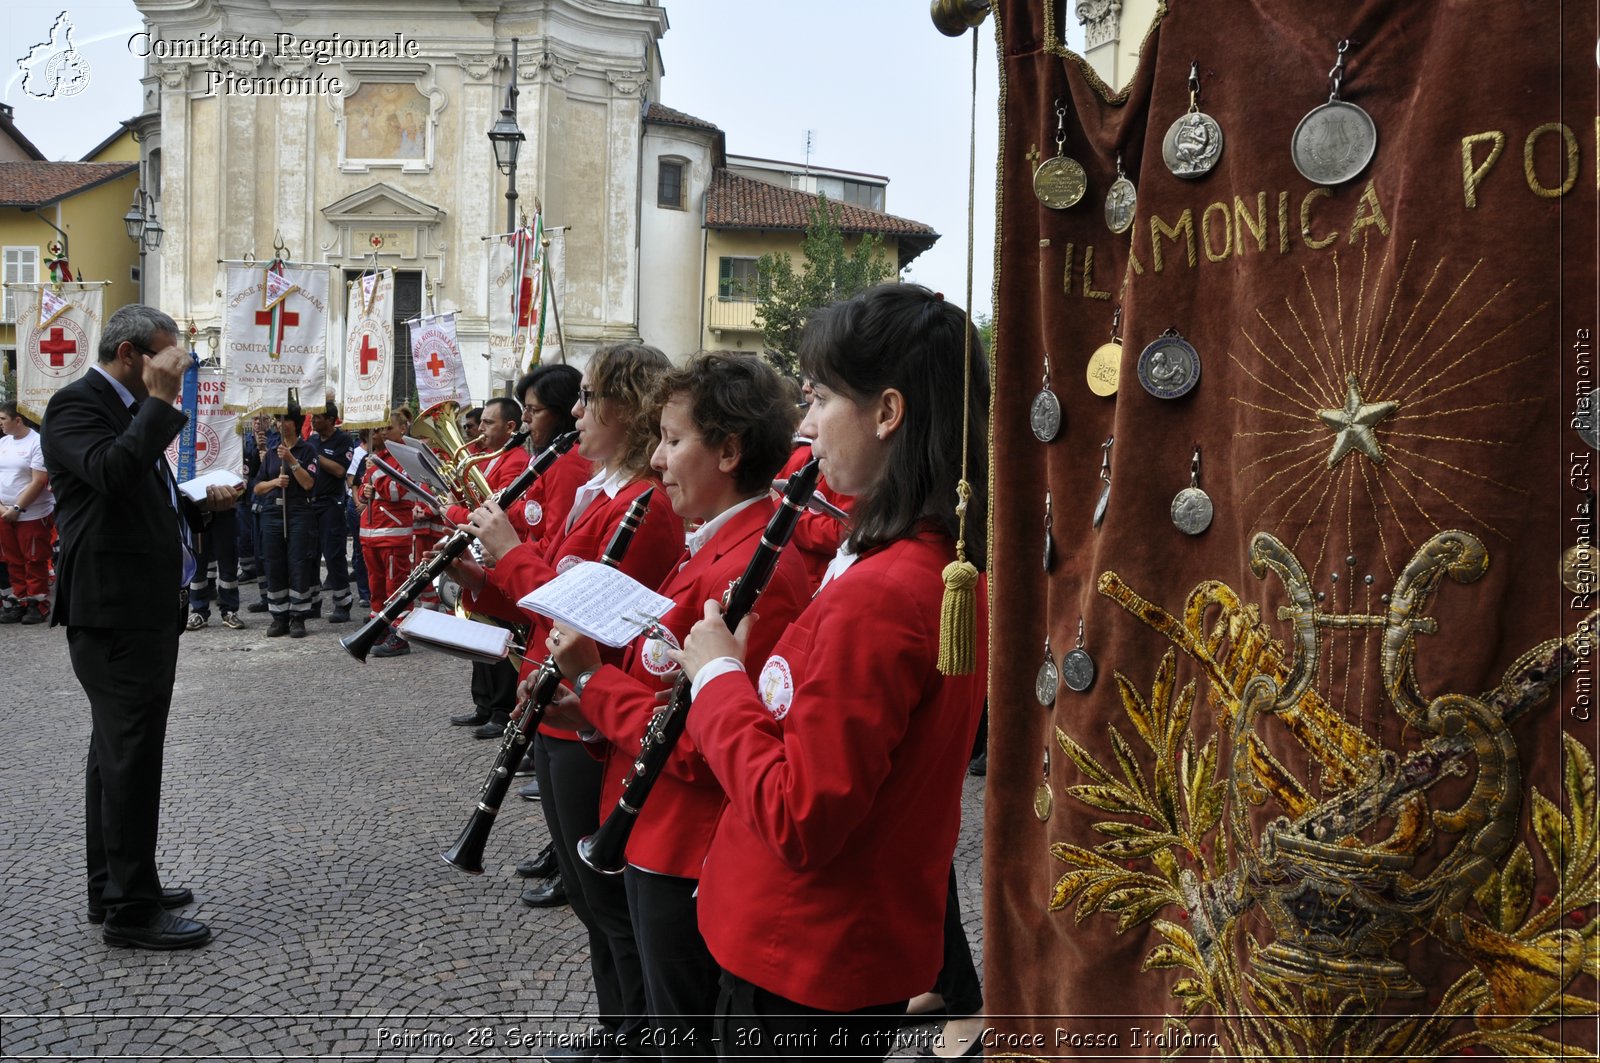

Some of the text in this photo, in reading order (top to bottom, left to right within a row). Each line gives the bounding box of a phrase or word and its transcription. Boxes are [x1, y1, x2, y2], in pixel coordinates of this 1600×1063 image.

[1461, 122, 1600, 208] PO
[284, 344, 320, 354] LOCALE
[244, 363, 304, 374] SANTENA
[197, 382, 226, 392] ROSS
[180, 450, 190, 463] DEL
